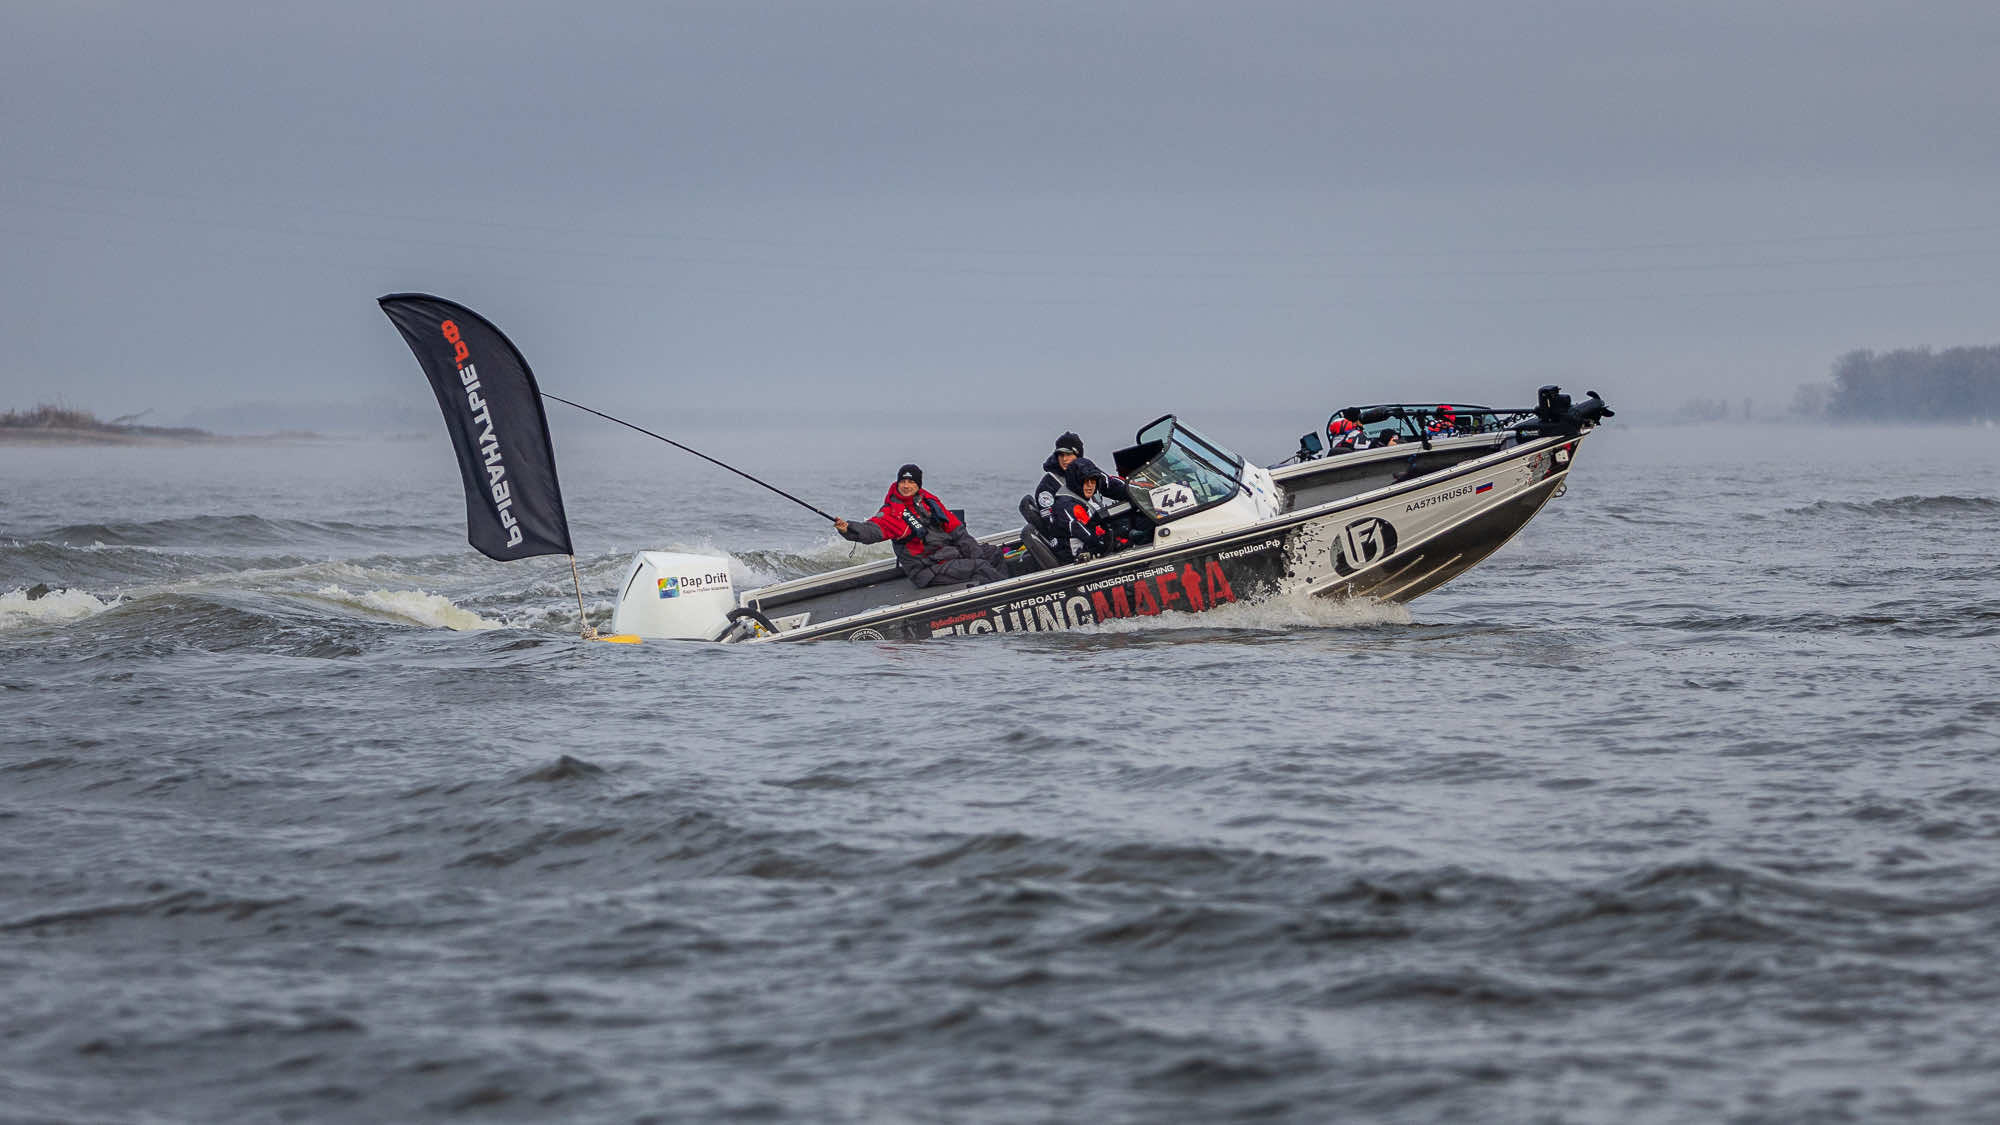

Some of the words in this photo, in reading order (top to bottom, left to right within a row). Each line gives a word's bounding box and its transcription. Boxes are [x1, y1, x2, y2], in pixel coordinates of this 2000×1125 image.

[1161, 489, 1188, 508] 44
[1405, 484, 1473, 513] AA5731RUS63
[680, 575, 703, 588] Dap
[705, 571, 728, 585] Drift
[1136, 564, 1175, 580] FISHING
[1010, 591, 1066, 611] MFBOATS
